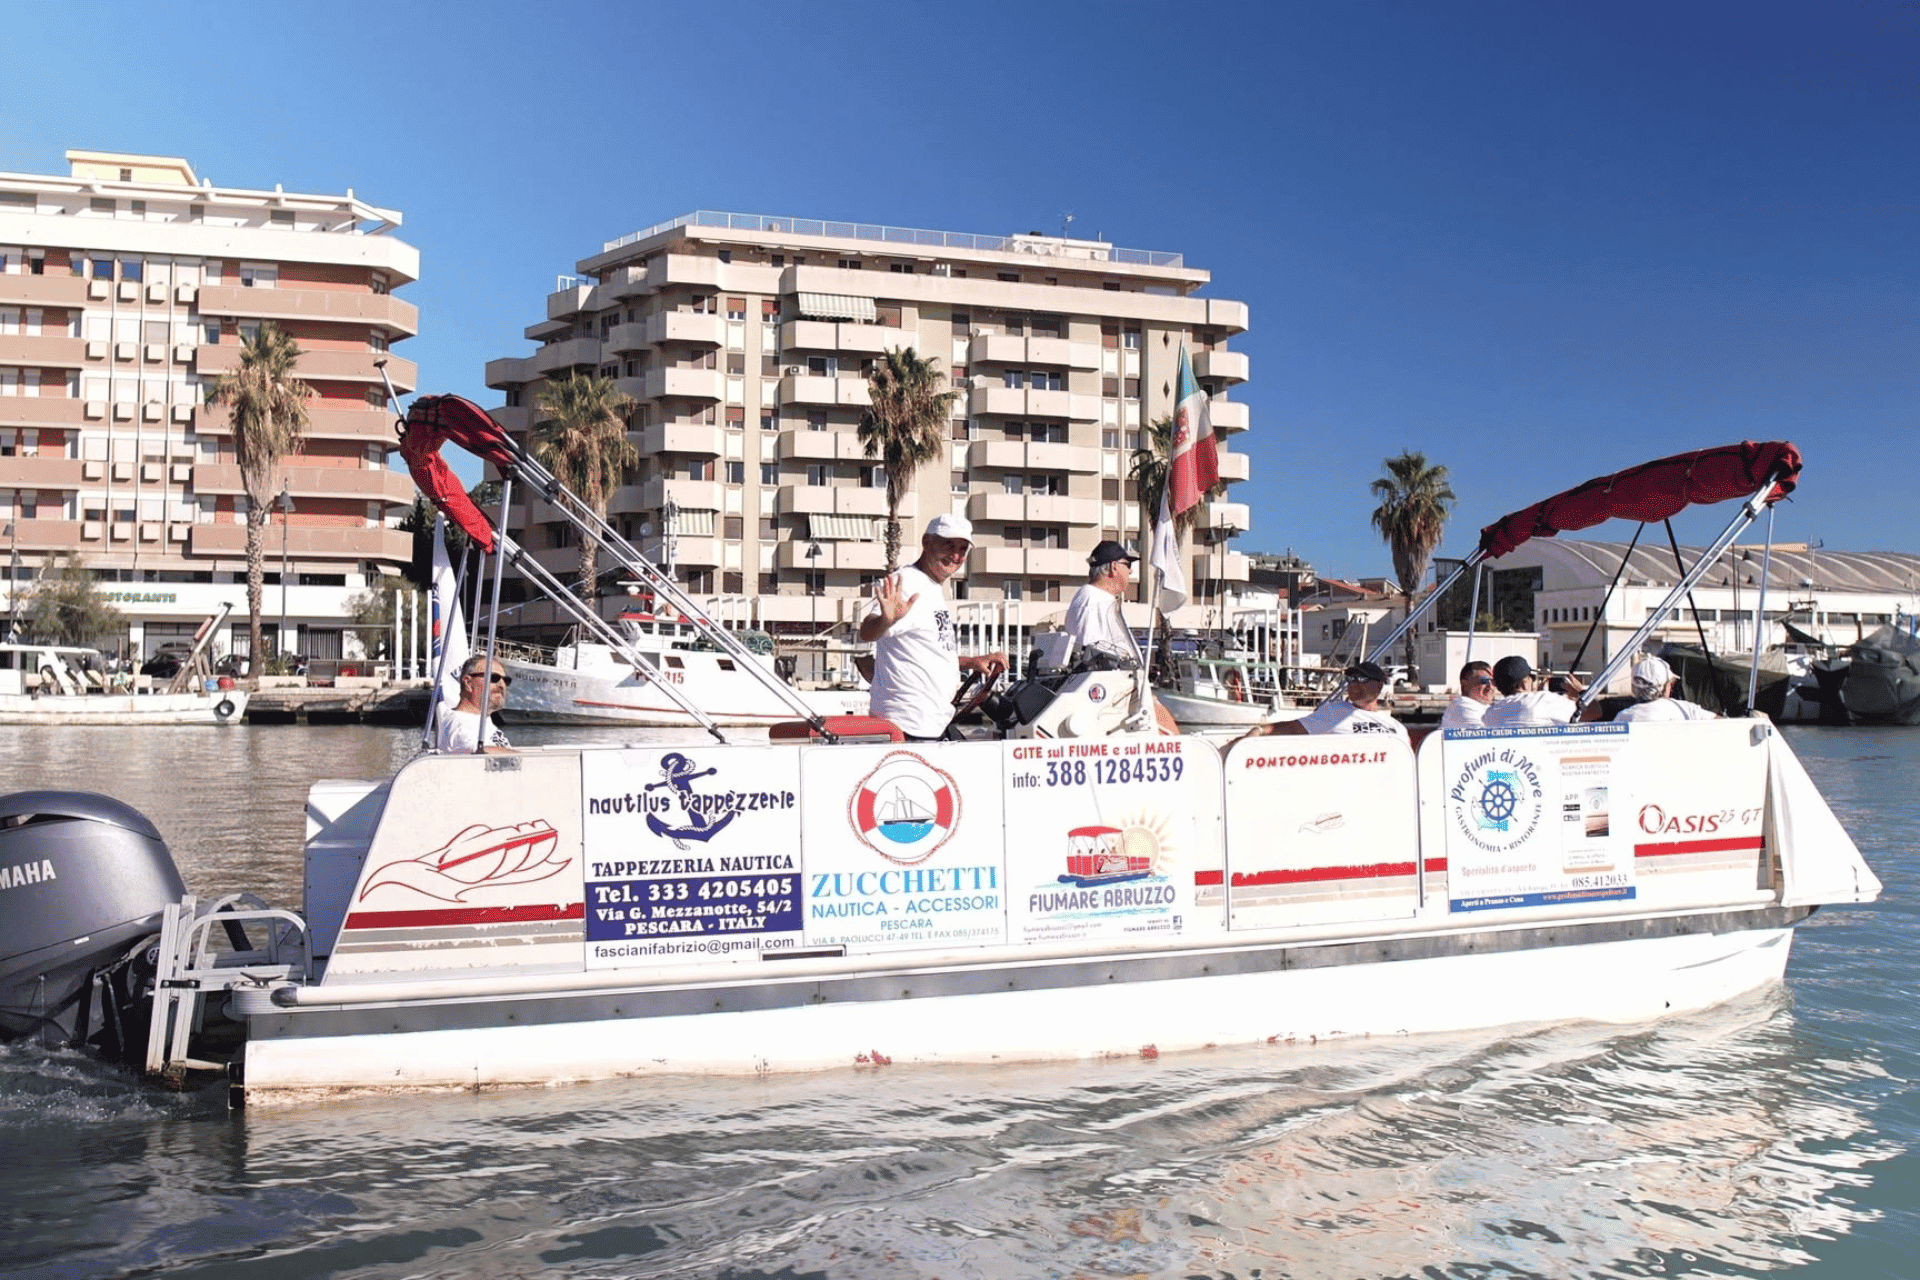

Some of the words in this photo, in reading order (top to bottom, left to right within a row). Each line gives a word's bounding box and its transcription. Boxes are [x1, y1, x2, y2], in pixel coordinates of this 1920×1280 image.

[1452, 729, 1487, 738] ANTIPASTI
[1491, 728, 1513, 736] CRUDI
[1517, 727, 1536, 735] PRIMI
[1537, 726, 1558, 735] PIATTI
[1563, 725, 1590, 734] ARROSTI
[1012, 747, 1043, 760] GITE
[1047, 745, 1064, 758] sul
[1069, 744, 1108, 757] FIUME
[1113, 747, 1120, 755] e
[1125, 743, 1140, 755] sul
[1145, 741, 1182, 754] MARE
[1246, 751, 1387, 768] PONTOONBOATS.IT
[1012, 772, 1041, 788] info:
[1046, 760, 1087, 786] 388
[1095, 757, 1184, 784] 1284539
[1451, 747, 1496, 803] profumi
[1500, 748, 1516, 764] di
[1513, 755, 1542, 798] Mare
[590, 792, 670, 815] nautilus
[1719, 809, 1735, 823] 25
[1741, 808, 1762, 825] GT
[1455, 806, 1501, 852] GASTRONOMIA
[592, 859, 715, 877] TAPPEZZERIA
[720, 855, 793, 872] NAUTICA
[595, 885, 640, 903] Tel.
[648, 883, 689, 901] 333
[698, 878, 792, 900] 4205405
[811, 866, 998, 898] ZUCCHETTI
[1572, 874, 1628, 888] 085.412033
[596, 908, 625, 921] Via
[630, 907, 647, 920] G.
[651, 904, 753, 919] Mezzanotte,
[757, 899, 792, 914] 54/2
[812, 901, 887, 918] NAUTICA
[905, 895, 999, 914] ACCESSORI
[1029, 890, 1099, 913] FIUMARE
[1104, 885, 1176, 908] ABRUZZO
[625, 921, 705, 936] PESCARA
[718, 916, 767, 931] ITALY
[880, 918, 933, 930] PESCARA
[595, 936, 794, 958] fascianifabrizio@gmail.com
[812, 937, 828, 945] VIA
[841, 934, 884, 944] PAOLUCCI
[886, 932, 910, 941] 47-49
[934, 930, 951, 938] FAX
